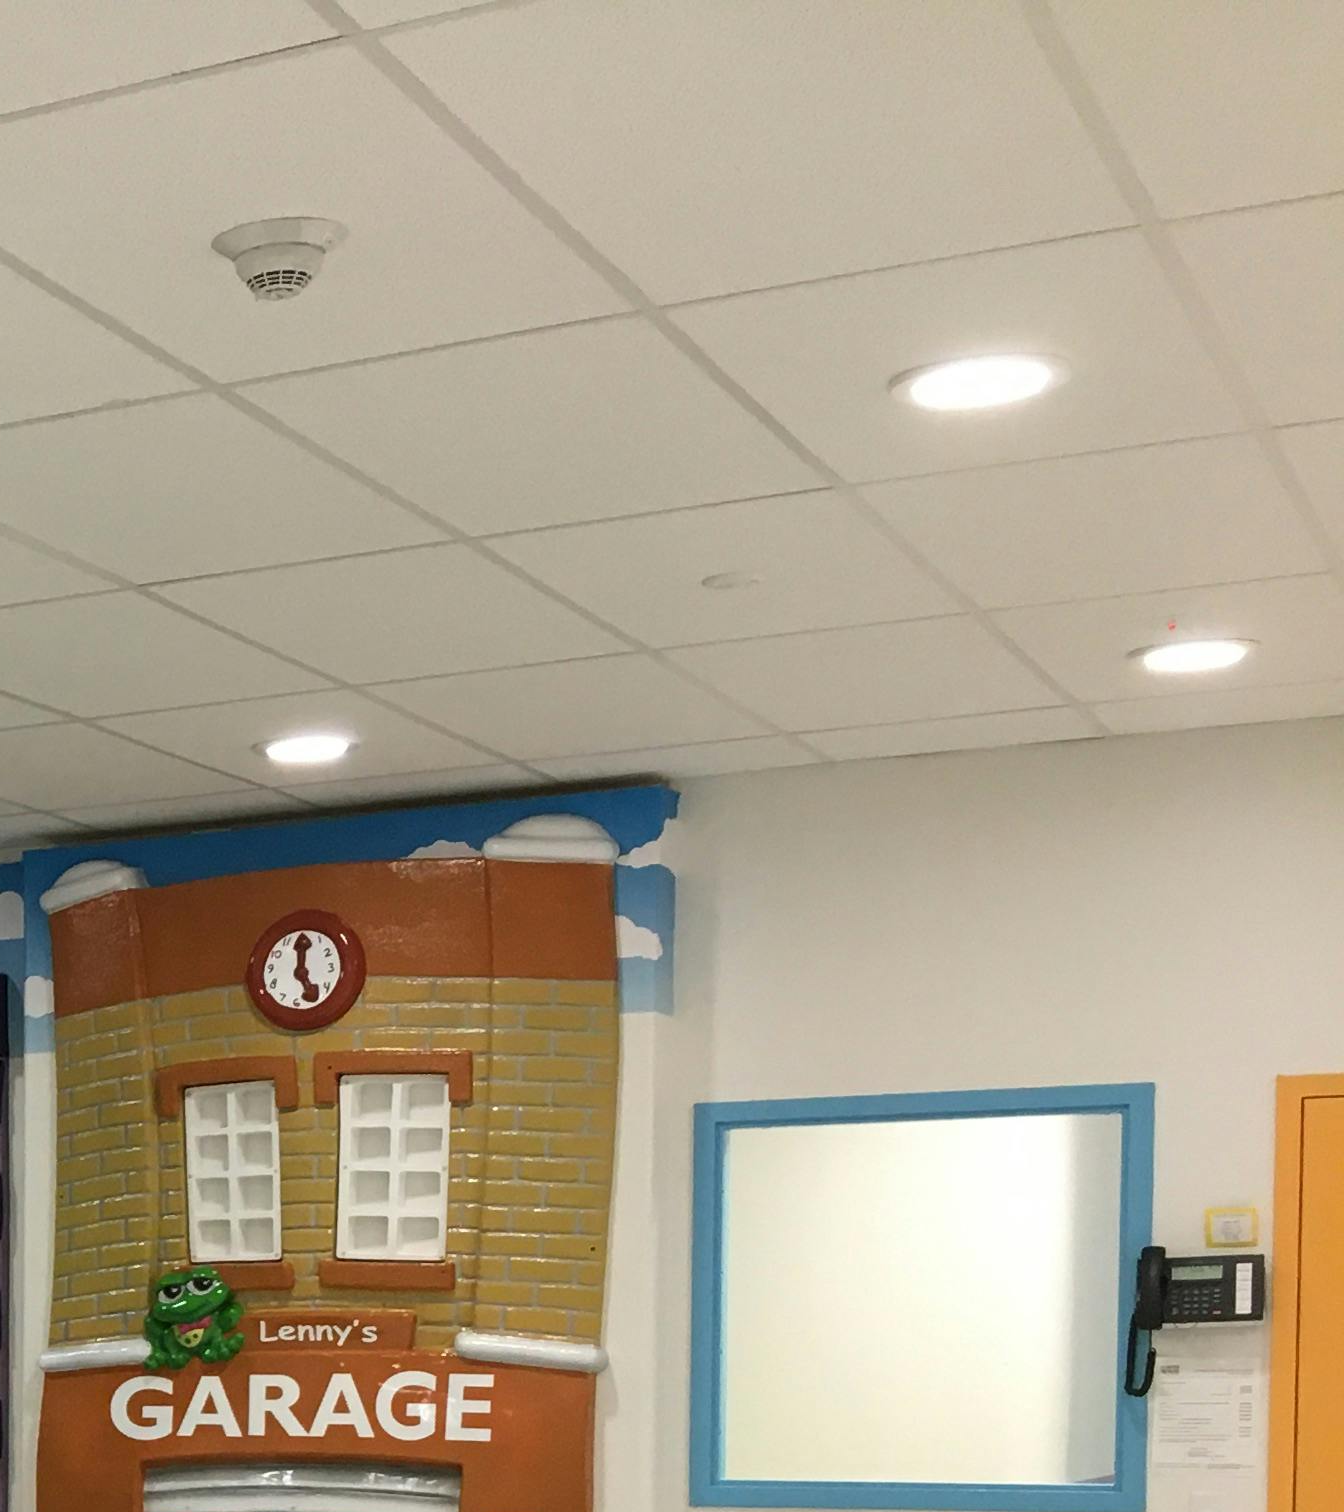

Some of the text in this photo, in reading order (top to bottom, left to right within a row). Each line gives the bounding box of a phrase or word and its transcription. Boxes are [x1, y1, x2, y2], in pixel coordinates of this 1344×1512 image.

[323, 948, 333, 958] 2
[269, 978, 278, 989] 8
[259, 1319, 378, 1347] Lenny's
[109, 1370, 495, 1442] GARAGE
